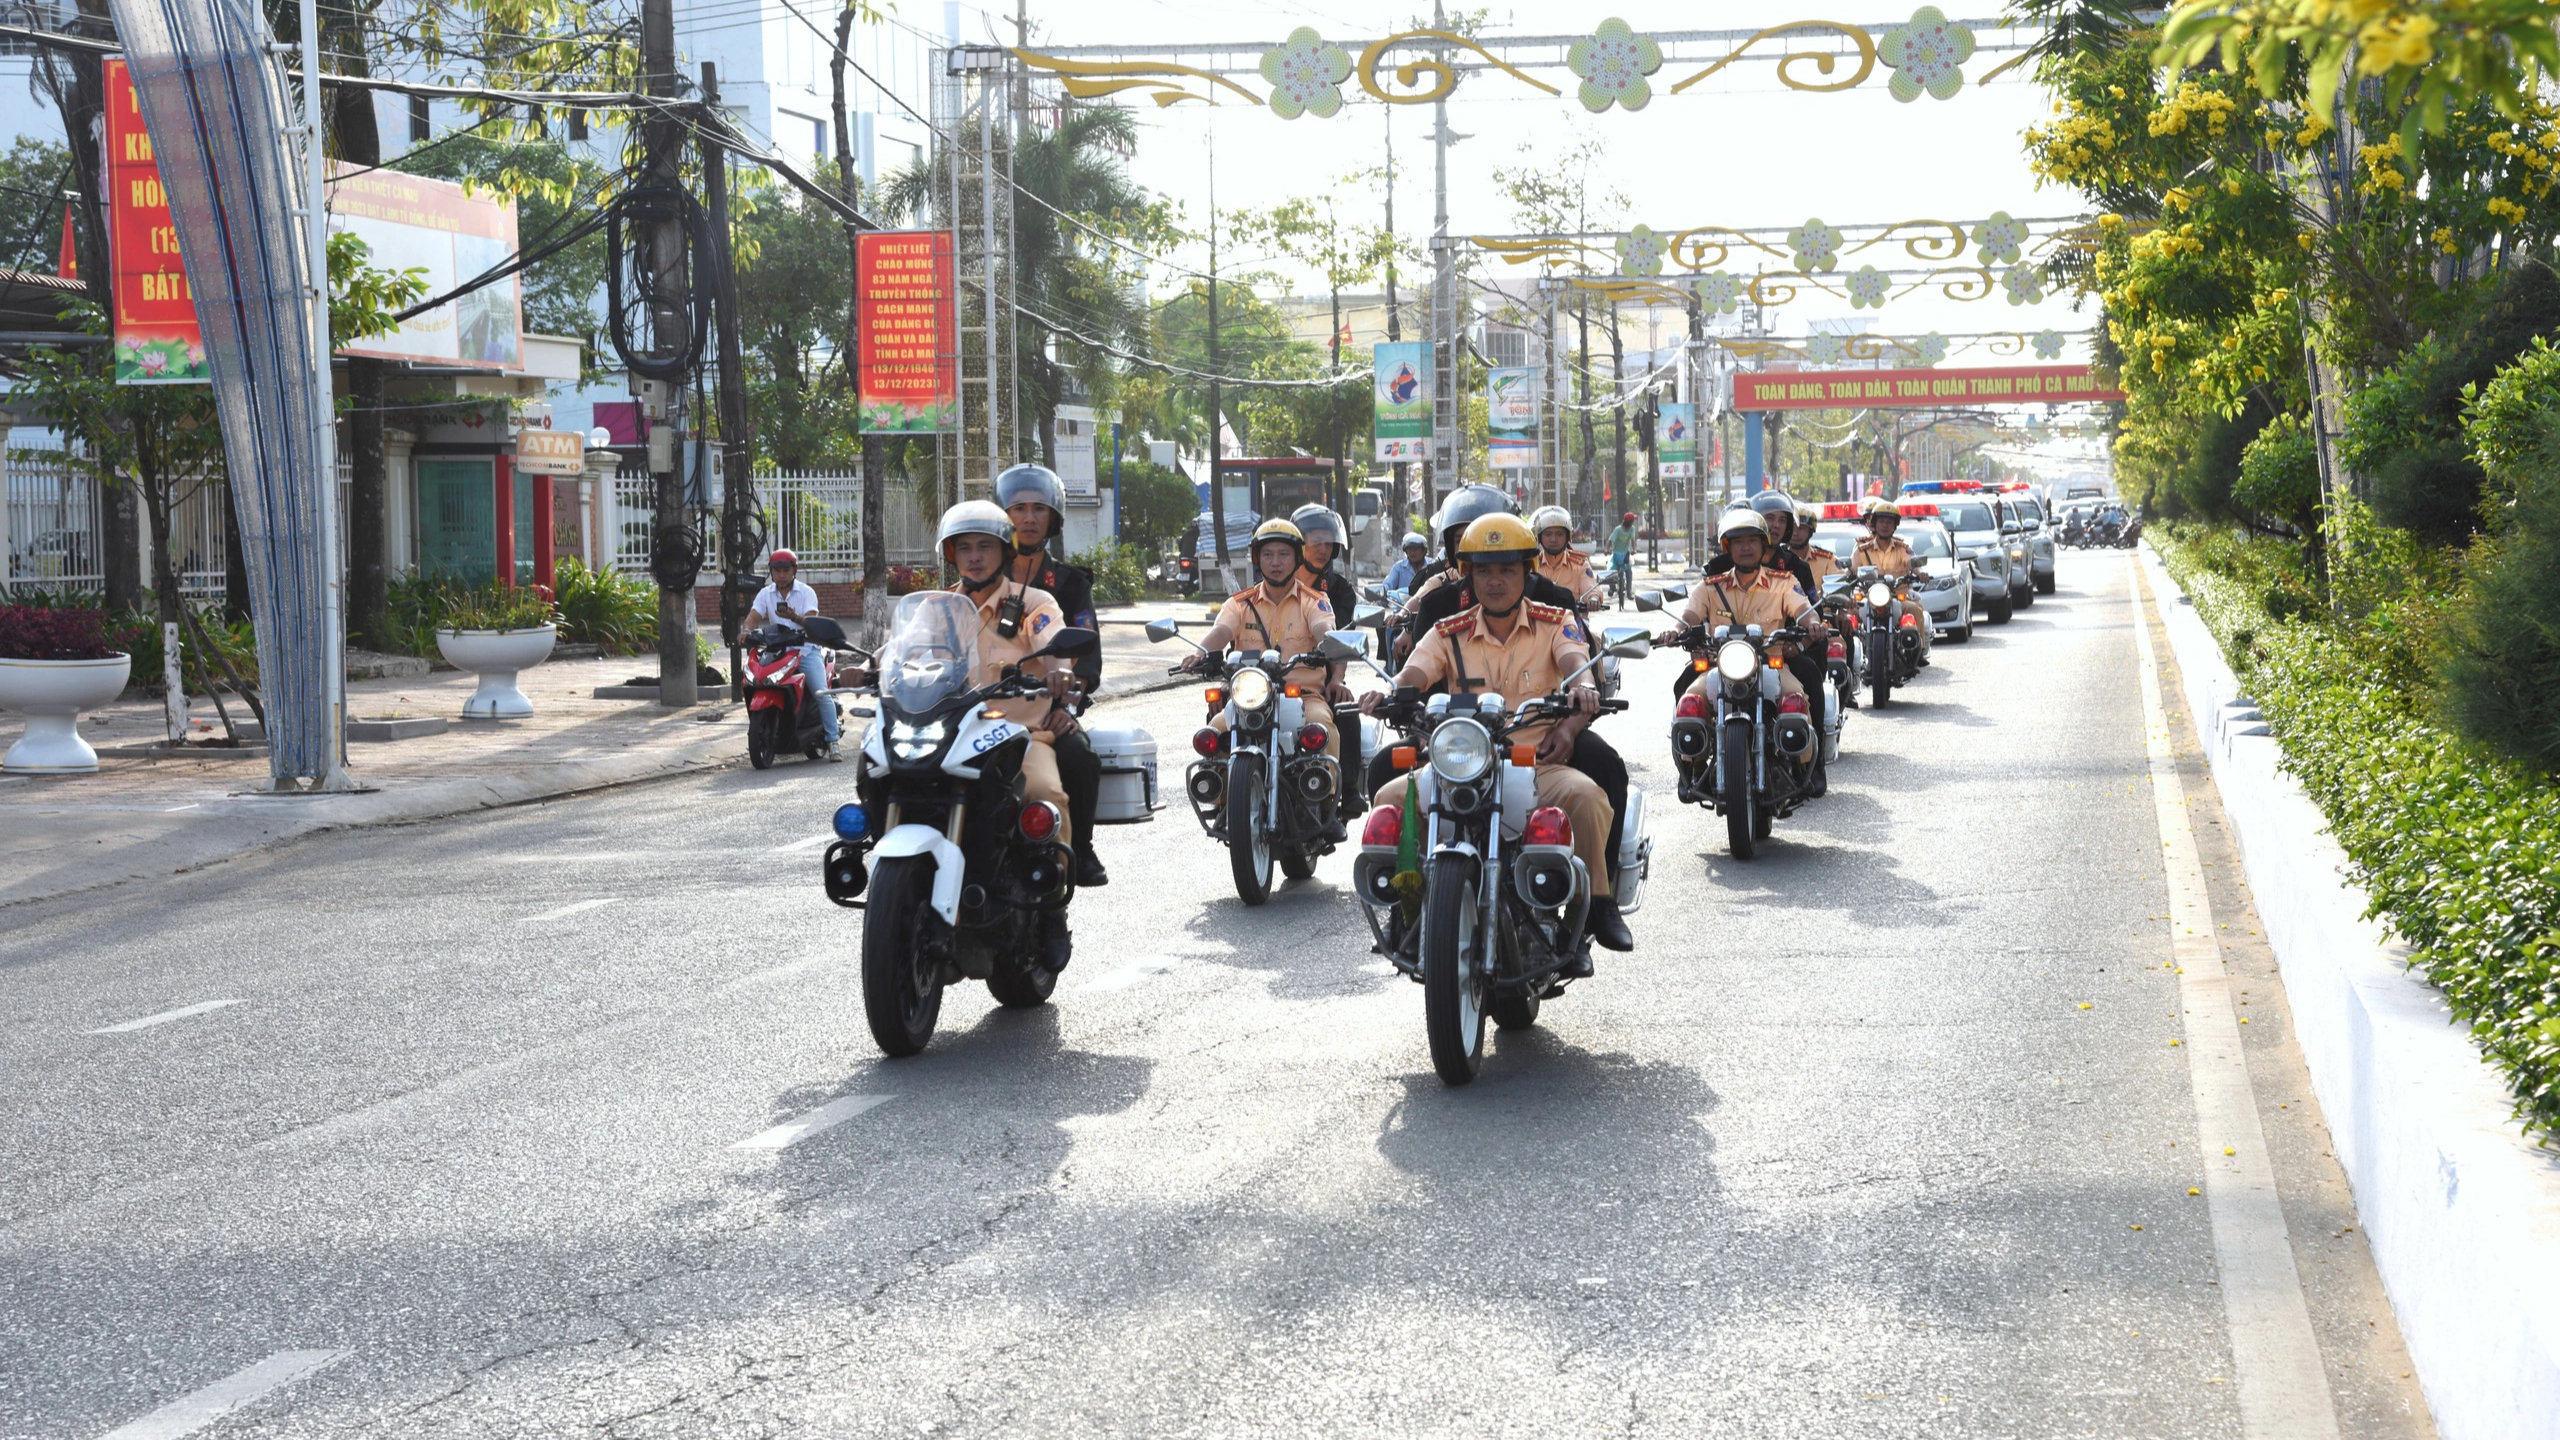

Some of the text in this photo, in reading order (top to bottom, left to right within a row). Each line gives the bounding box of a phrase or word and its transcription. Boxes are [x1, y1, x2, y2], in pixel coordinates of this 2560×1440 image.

[880, 243, 930, 256] NHIỆT LIỆT
[876, 258, 934, 269] CHÀO MỪNG
[142, 264, 180, 301] BẤT
[873, 274, 886, 285] 83
[888, 273, 910, 284] NĂM
[869, 286, 942, 299] TRUYỀN THỐNG
[877, 303, 935, 315] CÁCH MẠNG
[872, 317, 892, 329] CỦA
[895, 317, 921, 329] ĐẢNG
[874, 333, 938, 345] QUÂN VÀ DÂN
[876, 348, 938, 359] TỈNH CÀ MAU
[1754, 382, 1786, 401] TOÀN
[1789, 380, 1826, 401] ĐẢNG,
[1829, 380, 1862, 398] TOÀN
[1865, 379, 1893, 398] DÂN,
[1896, 378, 1929, 397] TOÀN
[1932, 377, 1966, 397] QUÂN
[1970, 377, 2012, 395] THÀNH
[2015, 372, 2041, 394] PHỐ
[2045, 374, 2063, 393] CÀ
[2066, 375, 2095, 392] MAU
[522, 435, 576, 456] ATM
[518, 461, 568, 471] TECHCOMBANK
[972, 724, 1013, 753] CSGT
